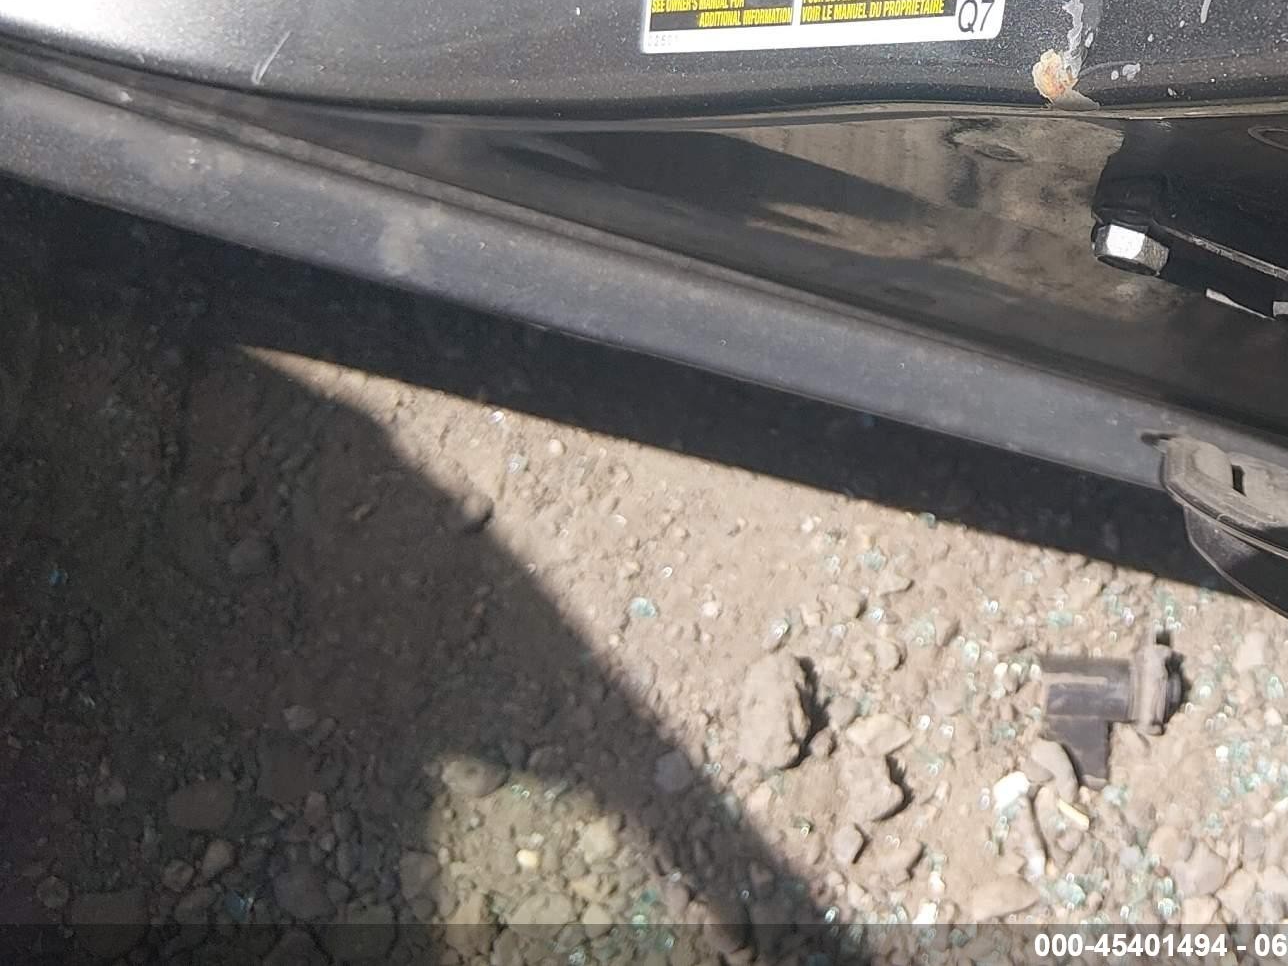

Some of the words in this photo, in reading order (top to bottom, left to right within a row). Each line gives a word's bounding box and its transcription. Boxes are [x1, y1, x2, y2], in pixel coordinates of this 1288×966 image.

[800, 4, 822, 22] VOIR
[821, 4, 833, 21] LE
[832, 1, 869, 20] MANUEL
[868, 0, 882, 18] DU
